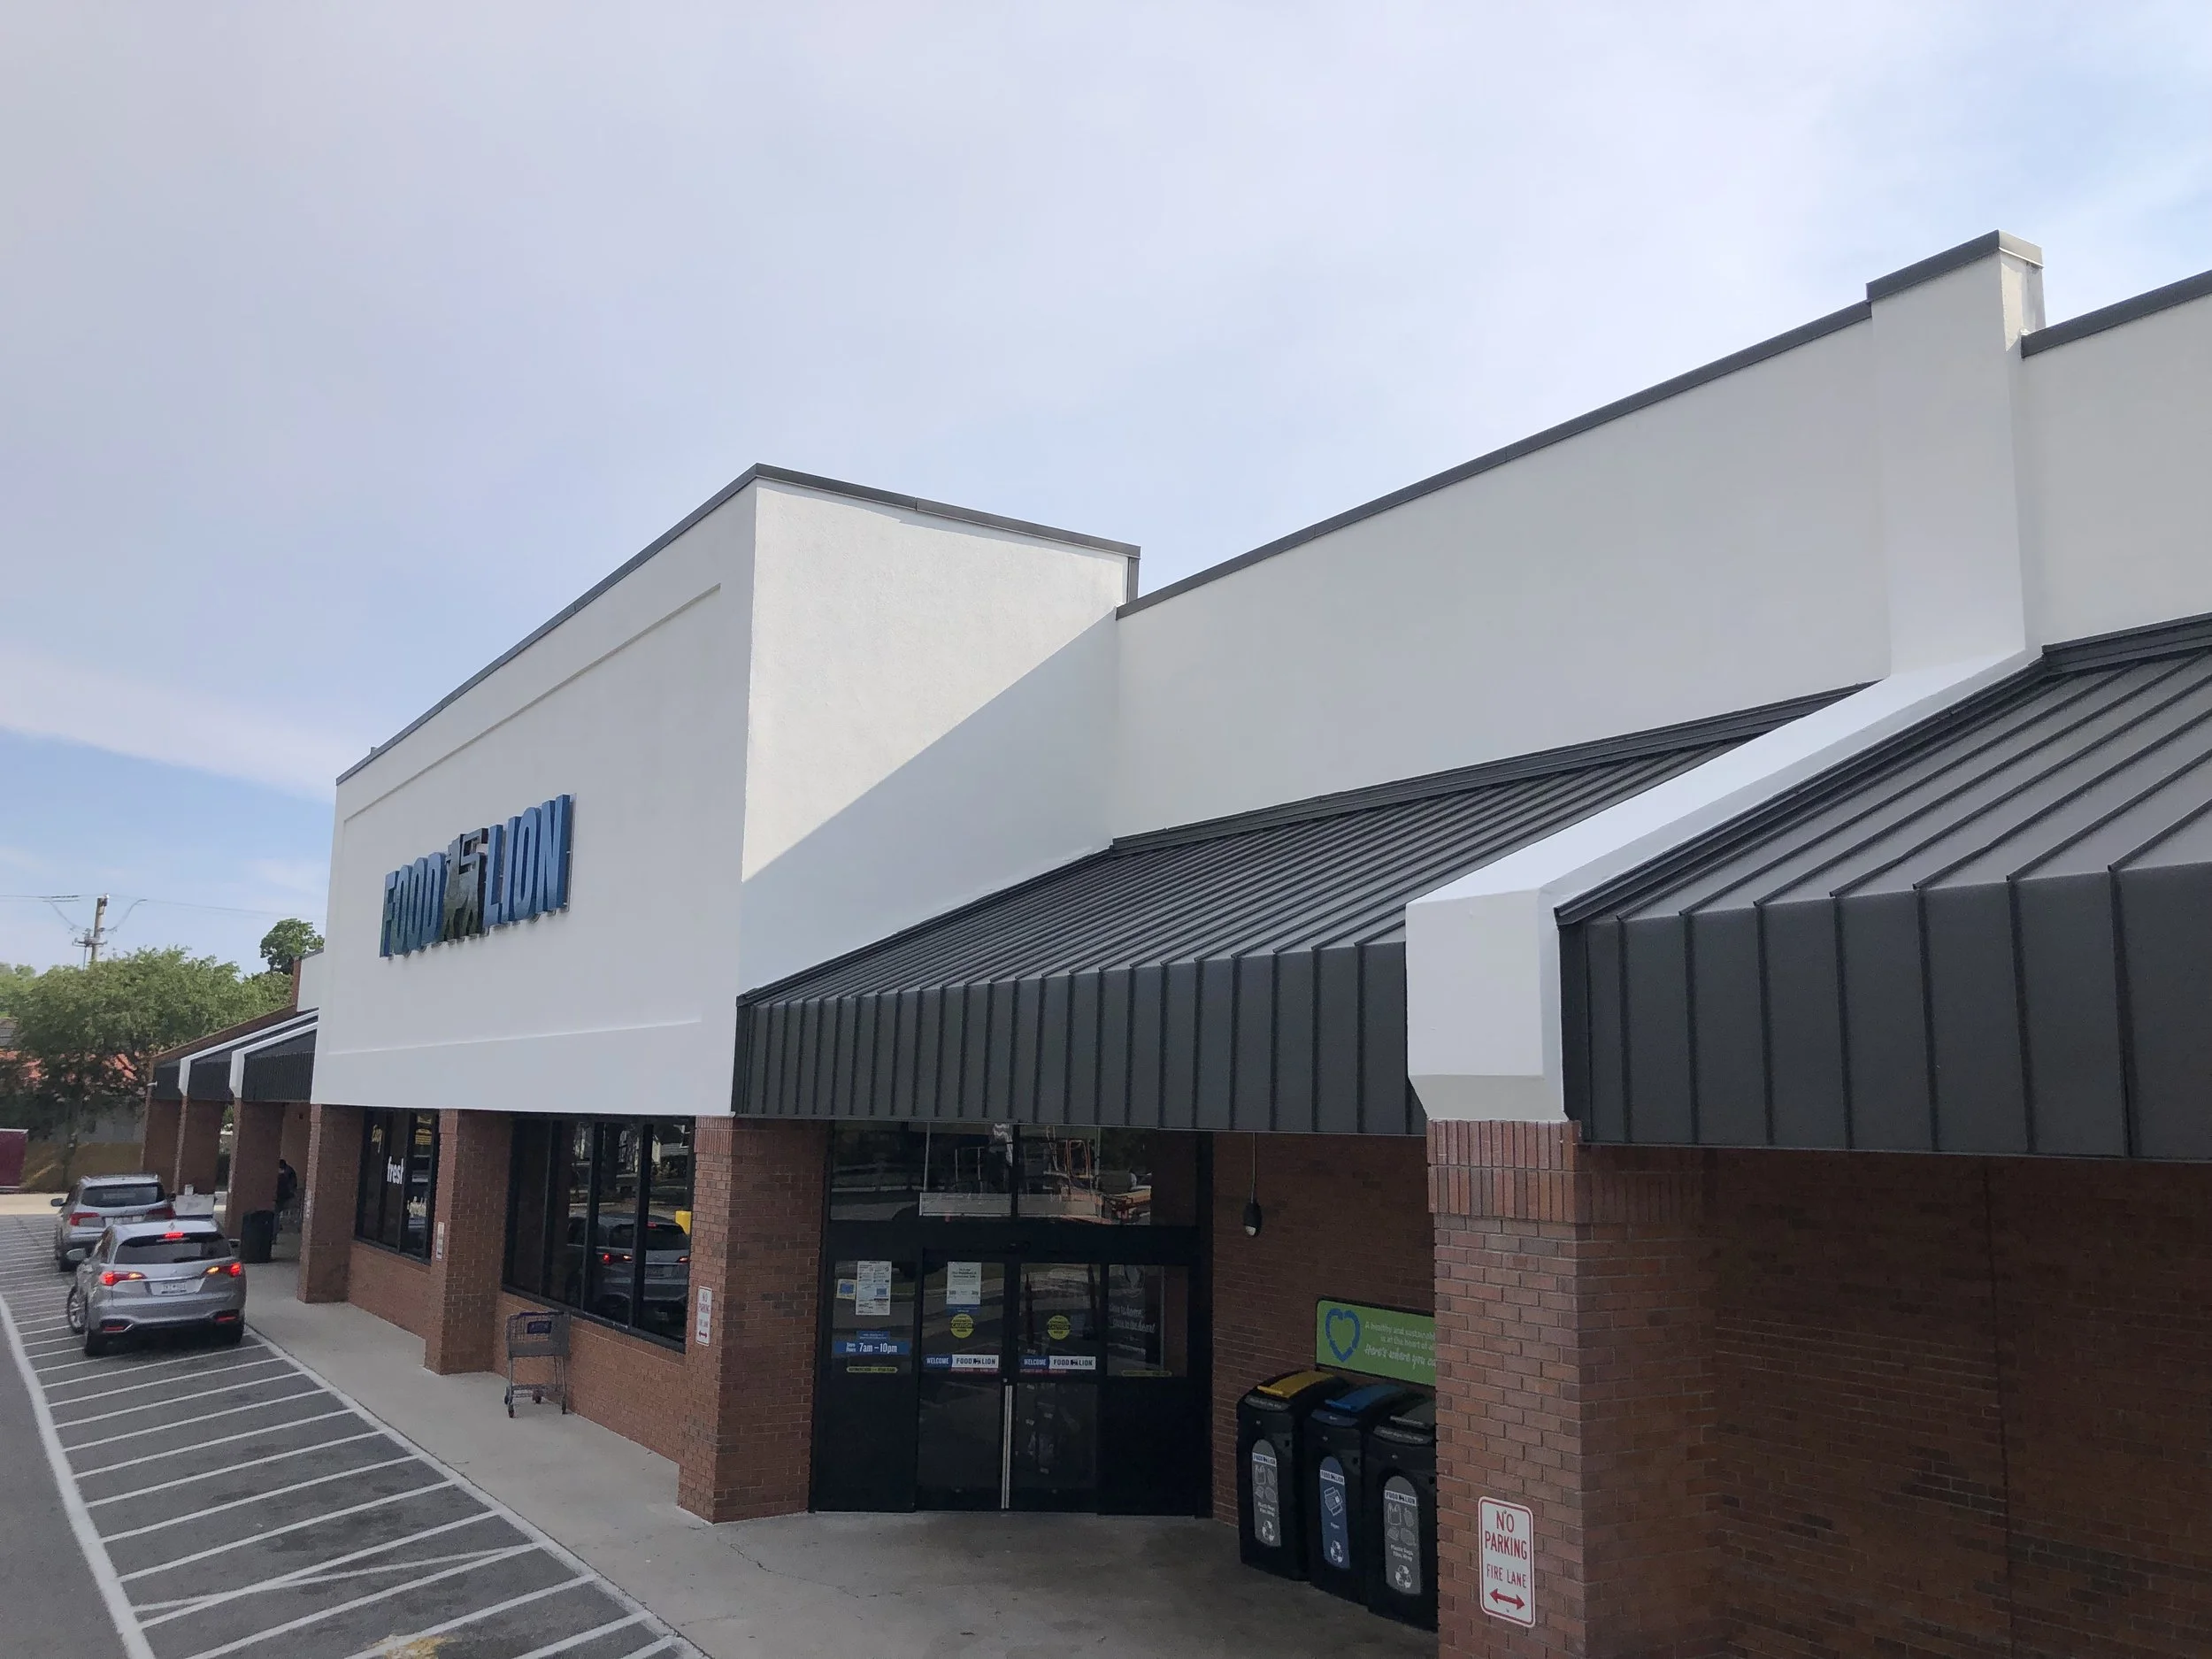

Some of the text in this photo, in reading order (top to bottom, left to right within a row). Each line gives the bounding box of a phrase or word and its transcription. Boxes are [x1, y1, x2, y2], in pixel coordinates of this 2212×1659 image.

[380, 795, 571, 956] FOOD LION
[1386, 1492, 1416, 1504] FOOD LION
[1496, 1510, 1515, 1532] NO
[1485, 1530, 1527, 1560] PARKING
[1486, 1563, 1527, 1589] FIRE LANE
